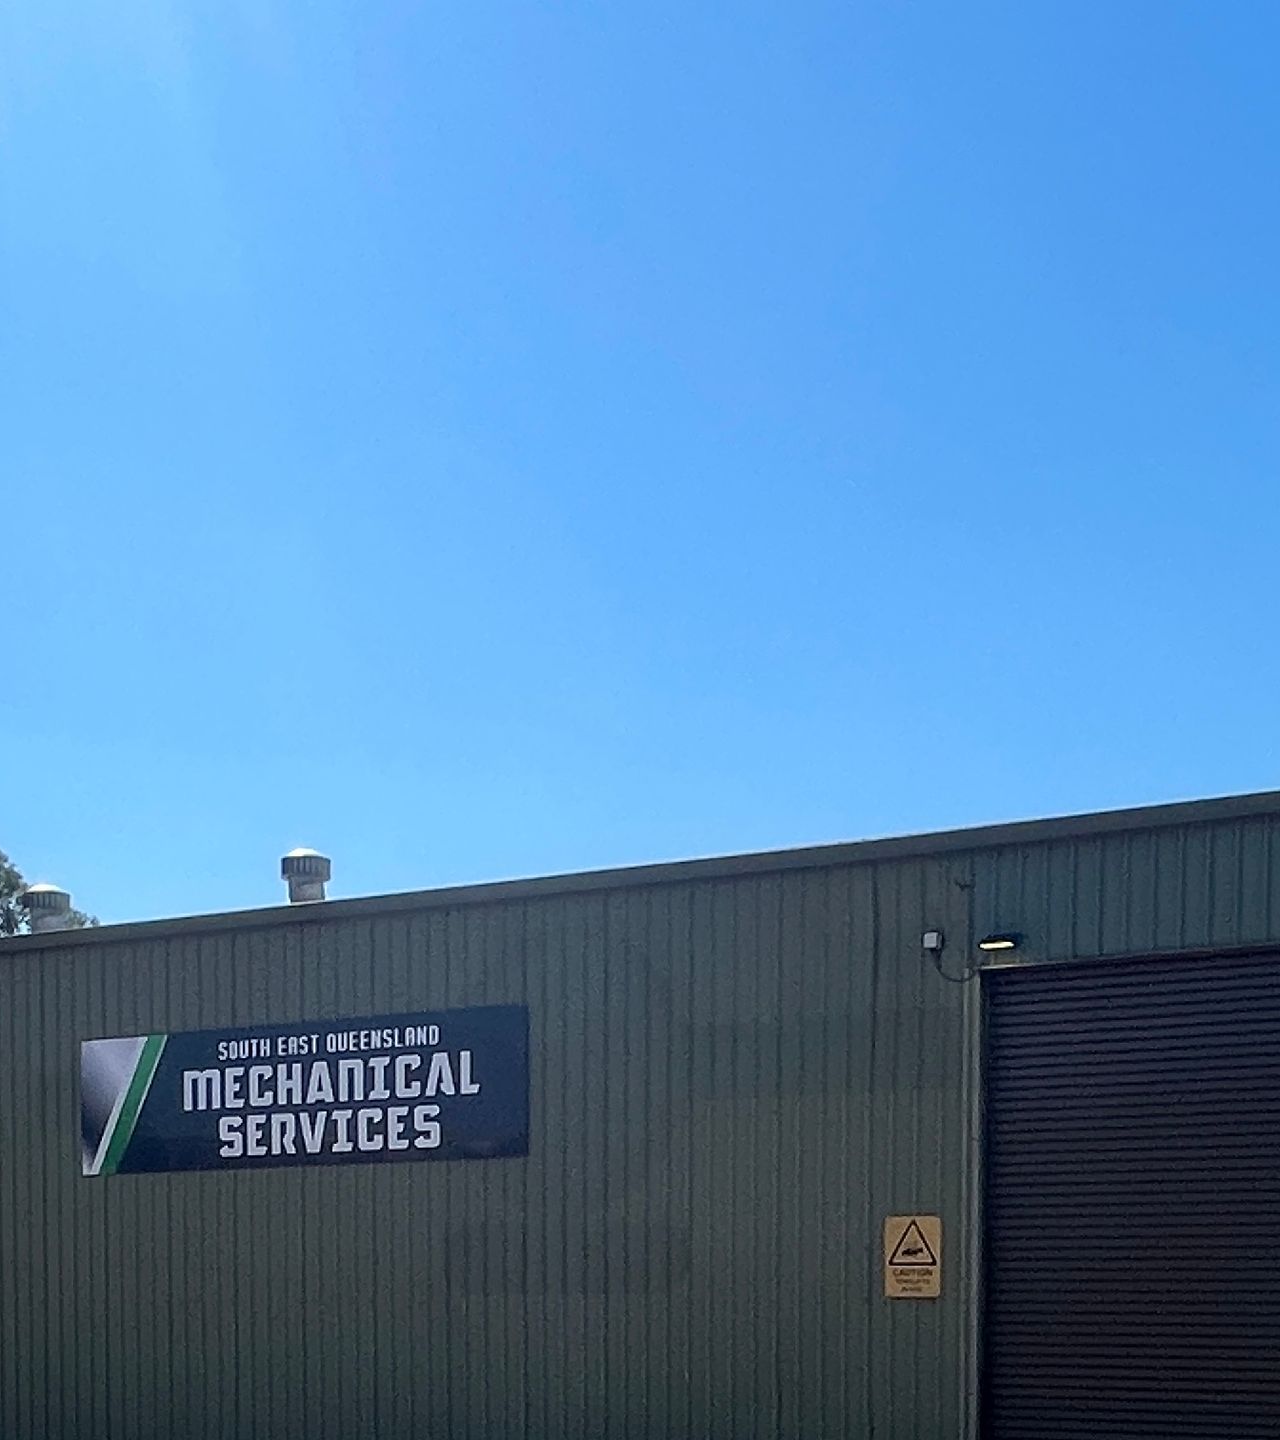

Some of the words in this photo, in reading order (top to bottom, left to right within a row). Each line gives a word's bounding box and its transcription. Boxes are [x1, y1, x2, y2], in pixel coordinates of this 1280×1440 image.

[218, 1038, 271, 1061] SOUTH
[277, 1034, 320, 1056] EAST
[326, 1025, 440, 1053] QUEENSLAND
[182, 1050, 480, 1111] MECHANICAL
[219, 1104, 441, 1158] SERVICES
